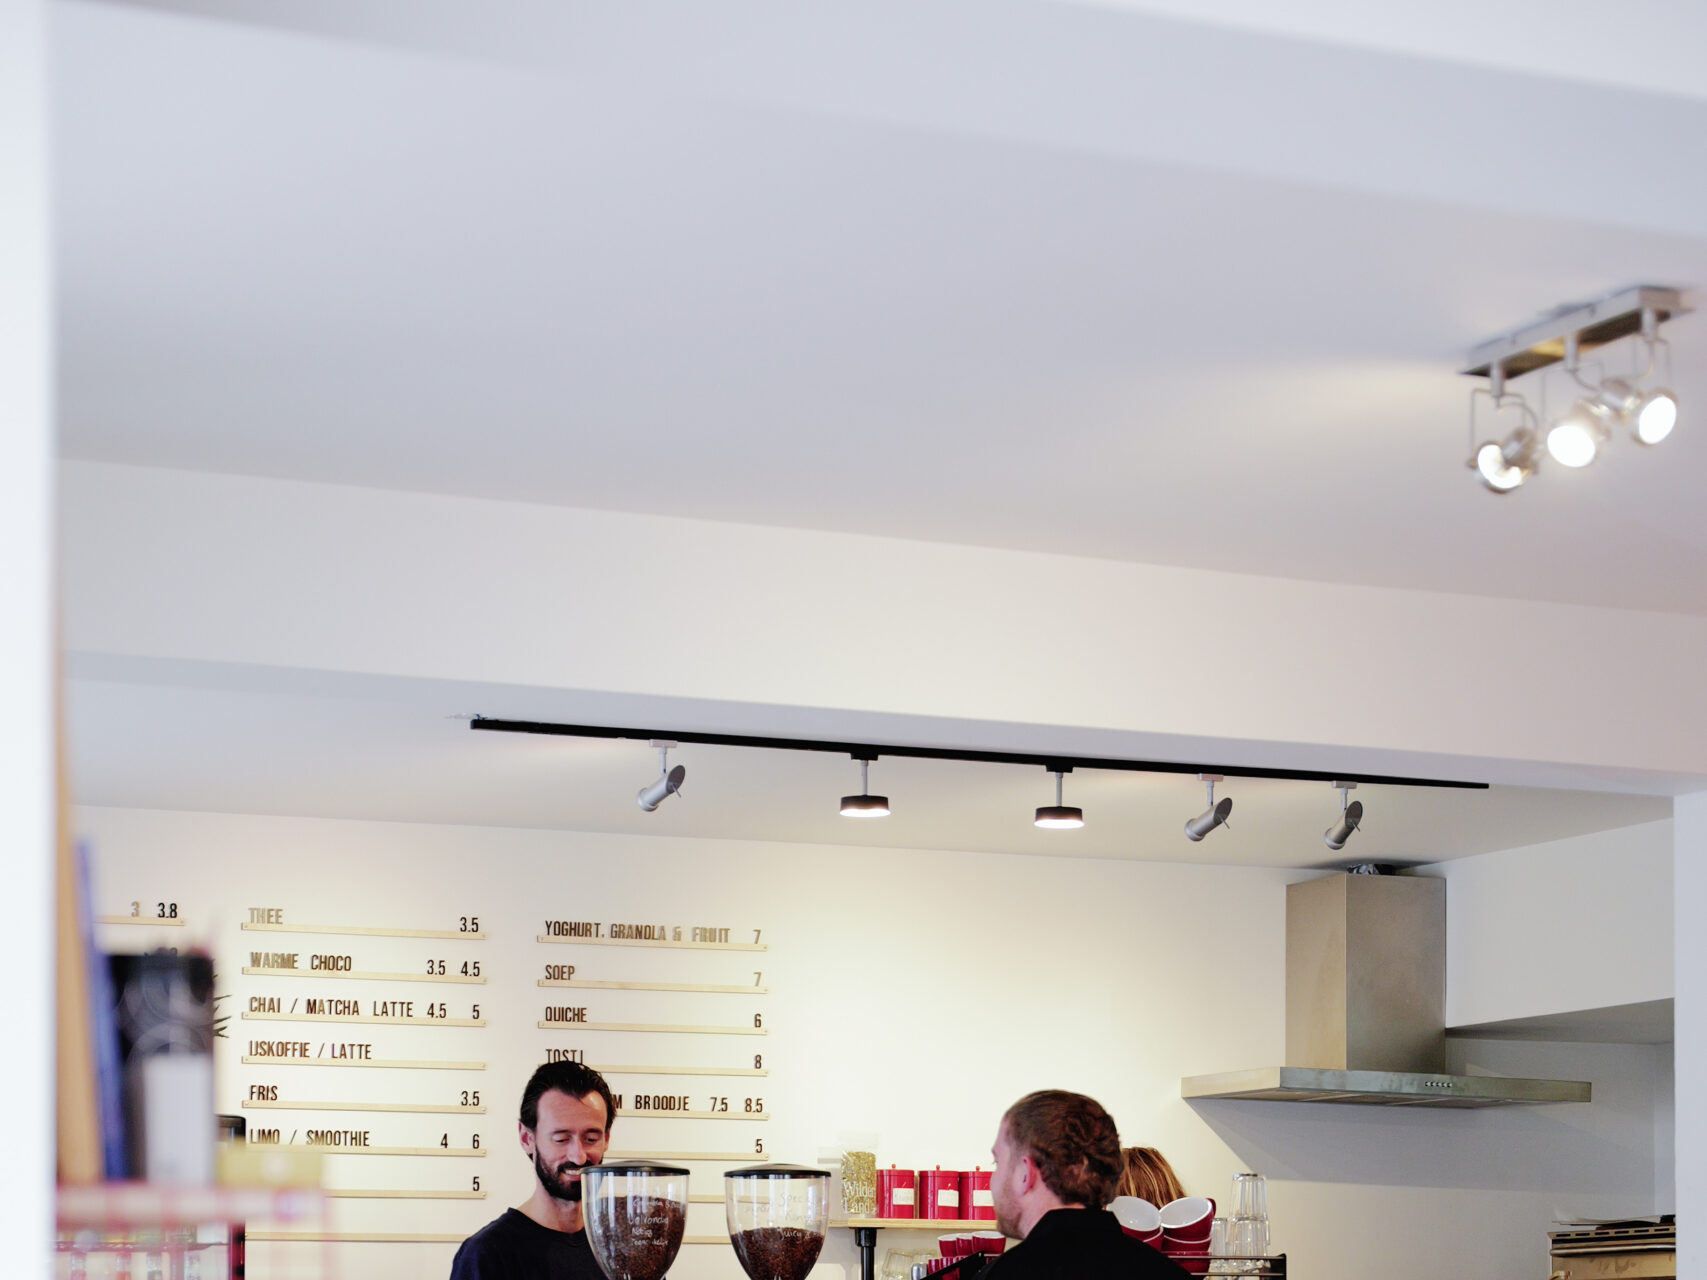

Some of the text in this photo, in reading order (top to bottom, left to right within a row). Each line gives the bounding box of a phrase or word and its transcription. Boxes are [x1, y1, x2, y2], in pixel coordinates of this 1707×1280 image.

[131, 901, 178, 919] 3 3.8
[248, 907, 479, 933] THEE 3.5
[610, 923, 667, 941] GRANOLA
[672, 926, 682, 942] &
[692, 926, 731, 943] FRUIT
[752, 929, 761, 945] 7
[250, 951, 480, 977] WARME CHOCO 3.5 4.5
[545, 964, 762, 987] SOEP 7
[249, 996, 480, 1020] CHAI / MATCHA LATTE 4.5 5
[545, 1006, 762, 1028] QUICHE 6
[249, 1040, 372, 1060] IJSKOFFIE / LATTE
[754, 1054, 762, 1070] 8
[250, 1085, 480, 1107] FRIS 3.5
[634, 1094, 690, 1111] BROODJE
[710, 1096, 728, 1112] 7.5
[744, 1097, 763, 1113] 8.5
[250, 1128, 480, 1149] LIMO / SMOOTHIE 4 6
[755, 1138, 763, 1154] 5
[472, 1176, 480, 1191] 5
[842, 1180, 876, 1199] Wilder
[843, 1197, 870, 1215] Land
